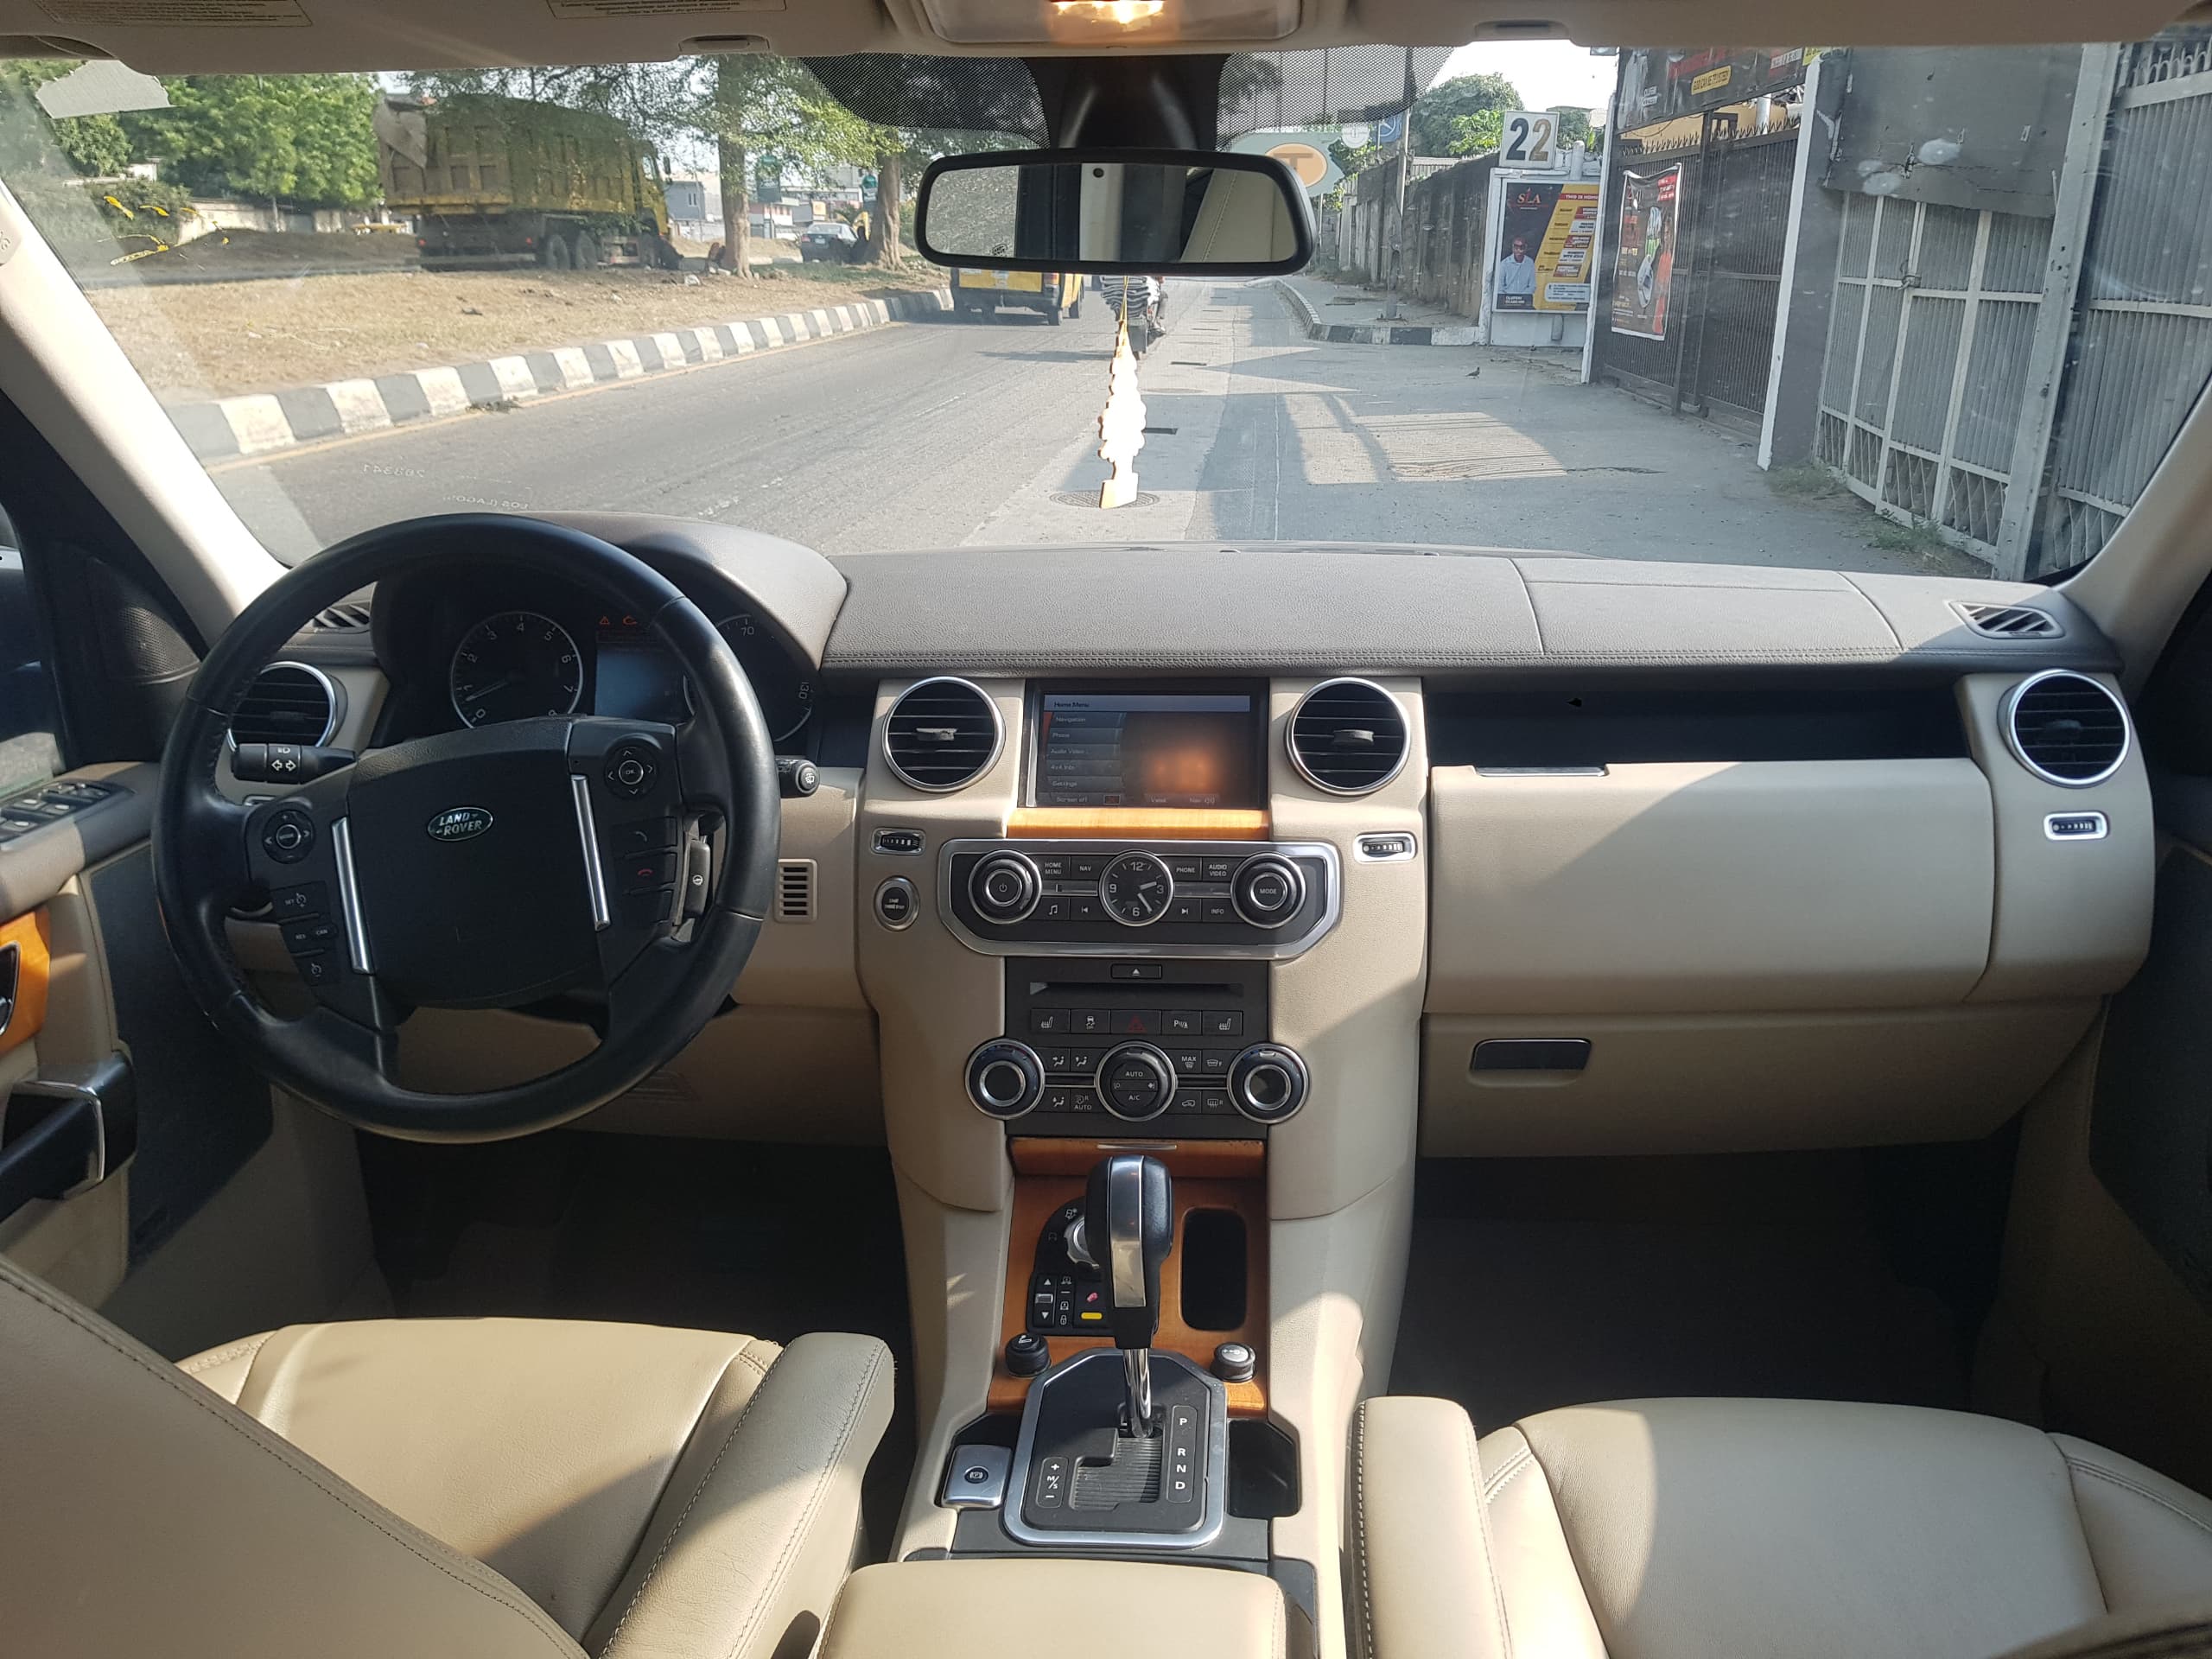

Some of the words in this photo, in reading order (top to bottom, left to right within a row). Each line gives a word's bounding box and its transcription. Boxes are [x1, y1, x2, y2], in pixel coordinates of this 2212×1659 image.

[1506, 118, 1551, 162] 22
[517, 623, 524, 632] 4
[741, 626, 754, 636] 70
[487, 631, 498, 640] 3
[544, 631, 554, 641] 5
[562, 654, 572, 664] 6
[798, 681, 810, 700] 130
[476, 709, 486, 719] 0
[439, 812, 470, 827] LAND
[443, 820, 482, 836] ROVER
[1130, 861, 1144, 872] 12
[1109, 883, 1117, 893] 9
[1156, 884, 1165, 894] 3
[1132, 906, 1141, 917] 6
[1179, 1417, 1187, 1426] P
[1177, 1447, 1186, 1457] R
[1176, 1465, 1186, 1473] N
[1175, 1481, 1185, 1490] D
